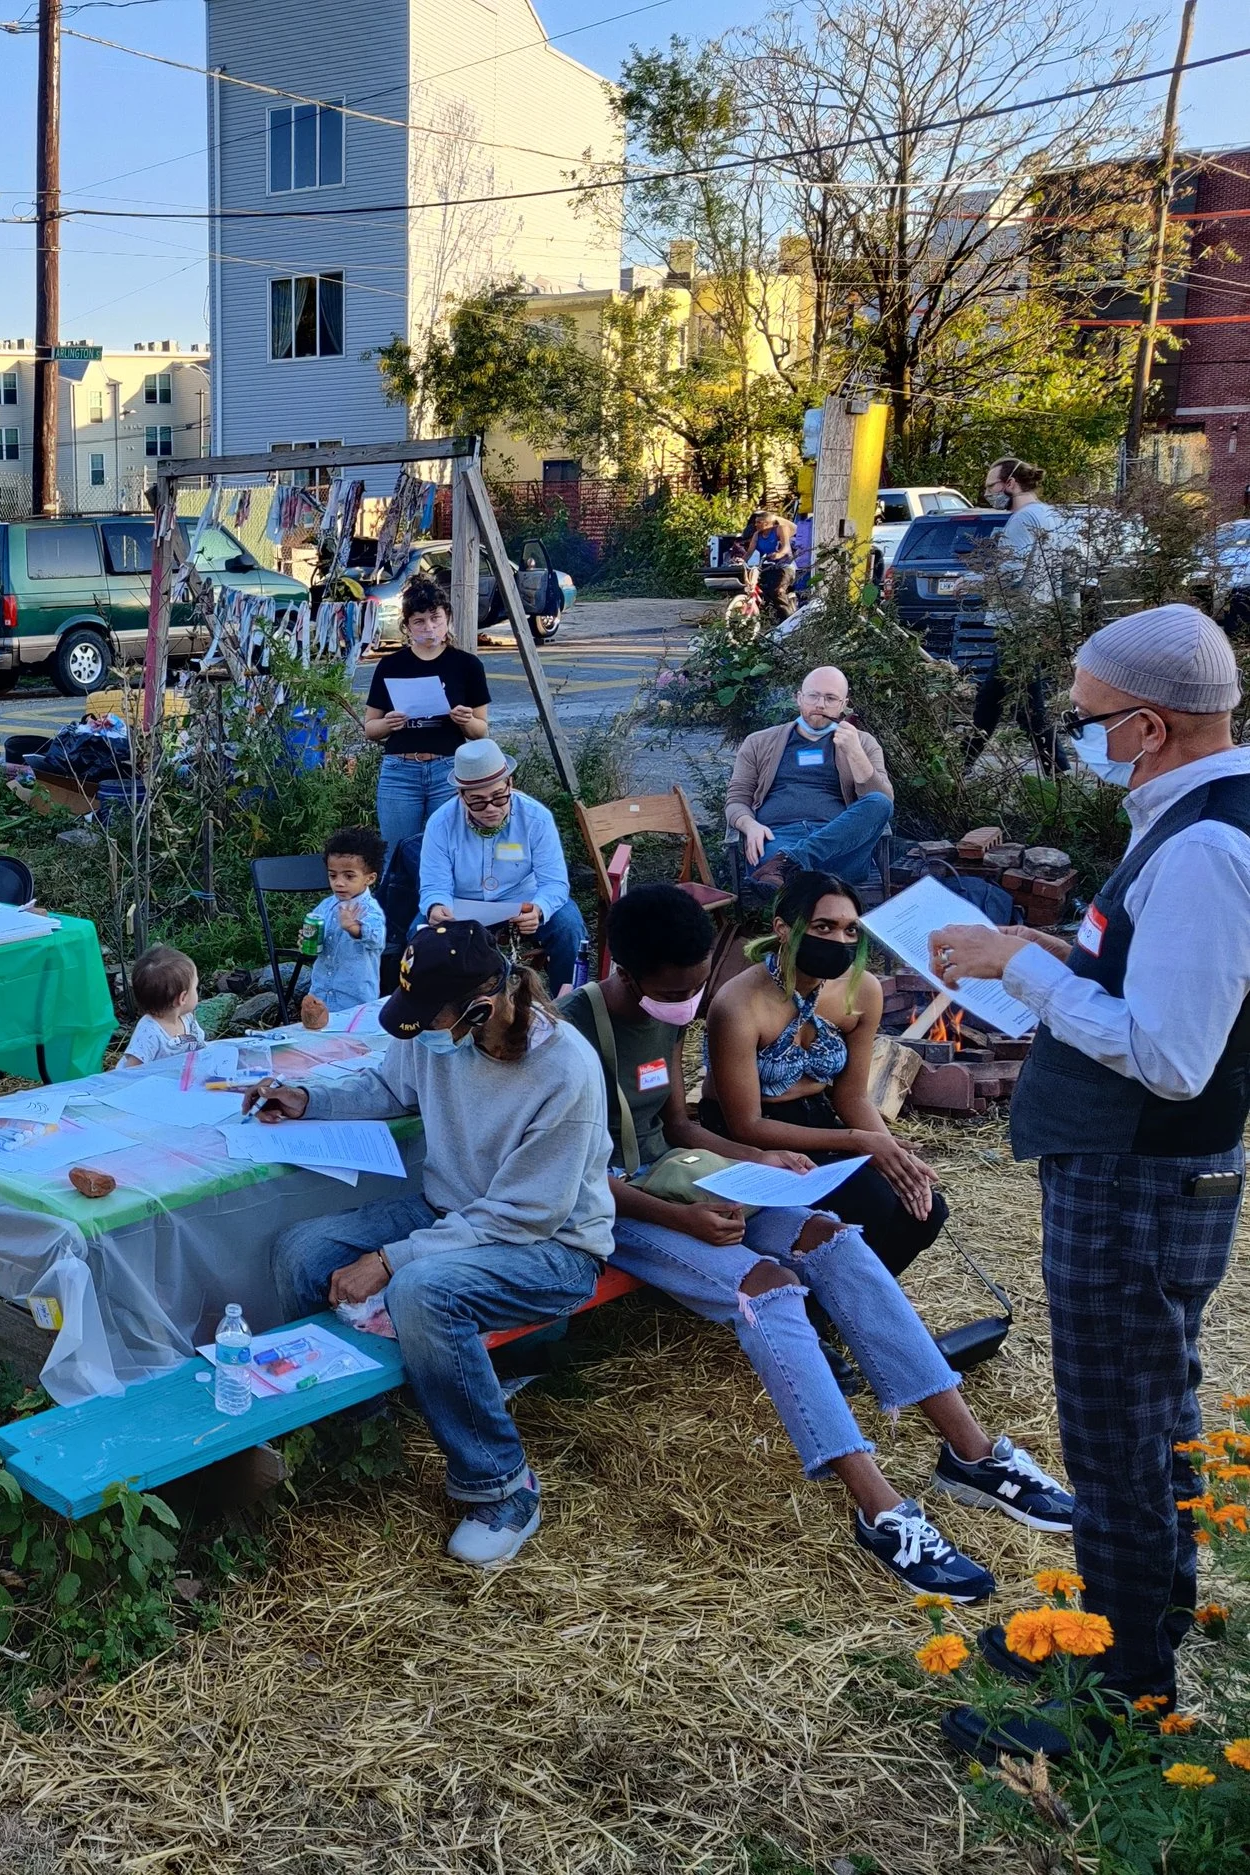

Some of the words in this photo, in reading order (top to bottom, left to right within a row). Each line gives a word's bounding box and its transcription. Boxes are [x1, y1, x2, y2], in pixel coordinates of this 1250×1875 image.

[56, 348, 94, 359] ARLINGTON
[399, 1021, 421, 1032] ARMY
[997, 1480, 1022, 1500] N
